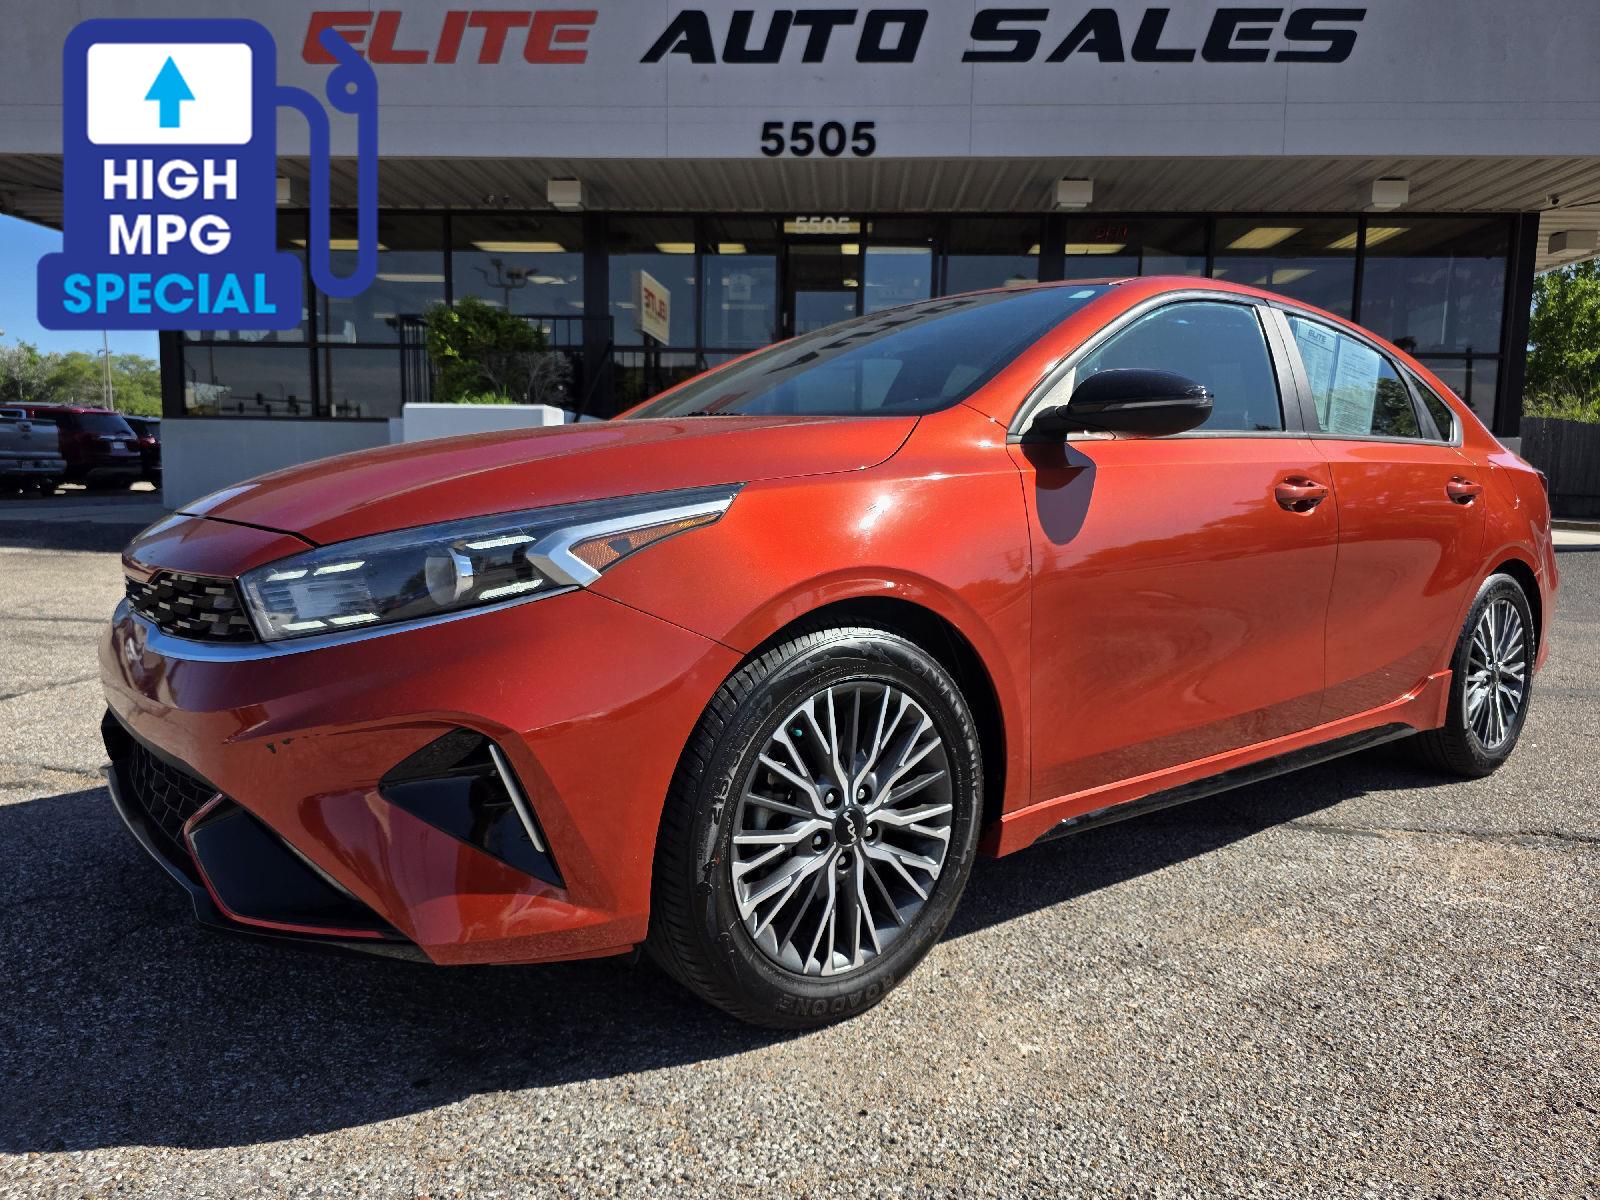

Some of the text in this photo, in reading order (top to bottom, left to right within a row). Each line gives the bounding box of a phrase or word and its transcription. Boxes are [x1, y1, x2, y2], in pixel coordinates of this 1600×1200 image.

[302, 8, 1368, 65] ELITE AUTO SALES
[761, 121, 877, 157] 5505
[795, 216, 850, 234] 5505
[1308, 329, 1327, 343] ELITE
